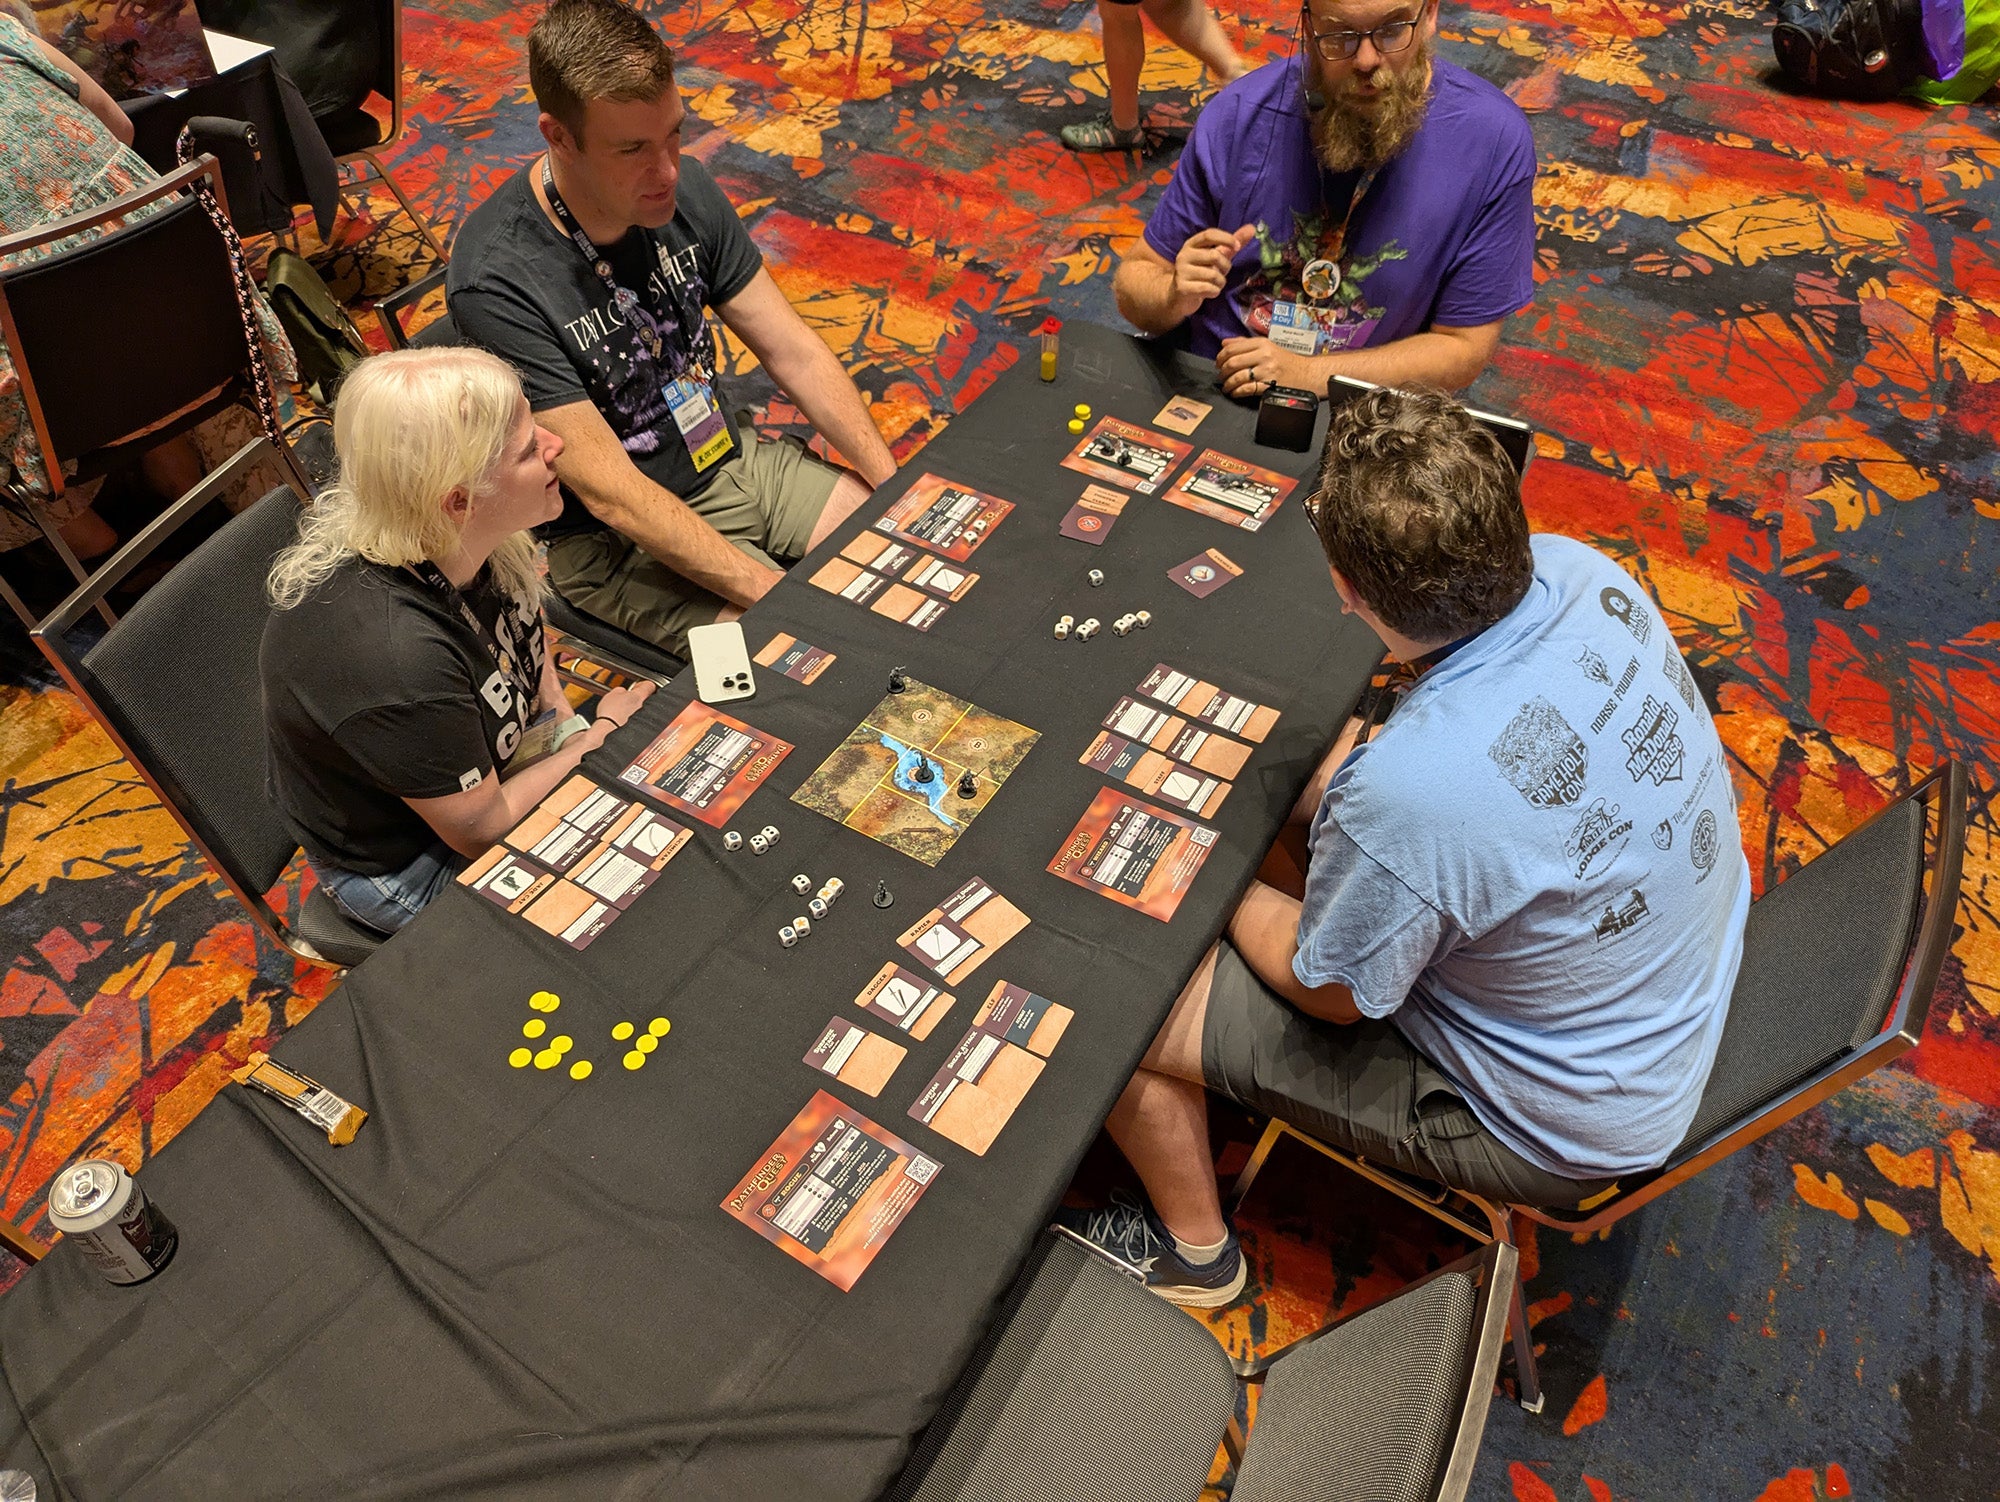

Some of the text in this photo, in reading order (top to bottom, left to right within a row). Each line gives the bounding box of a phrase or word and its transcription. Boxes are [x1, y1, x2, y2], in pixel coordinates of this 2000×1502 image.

[564, 299, 626, 351] TAYLO
[1589, 698, 1618, 734] NORSE
[1620, 695, 1662, 751] Ronald
[1626, 703, 1679, 780] McDonald
[1645, 733, 1686, 786] House
[1528, 740, 1586, 809] GAMEHOLE
[1559, 777, 1587, 807] CON
[660, 836, 683, 862] SCIMITAR
[1053, 831, 1086, 873] PATHFINDER
[1574, 819, 1632, 879] LODGE CON
[517, 882, 543, 904] JADE CAT
[909, 919, 931, 937] RAPIER
[866, 973, 887, 996] DAGGER
[986, 998, 995, 1009] ELF
[729, 1151, 782, 1210] PATHFINDER
[755, 1156, 788, 1192] QUEST
[780, 1171, 802, 1196] ROGUE
